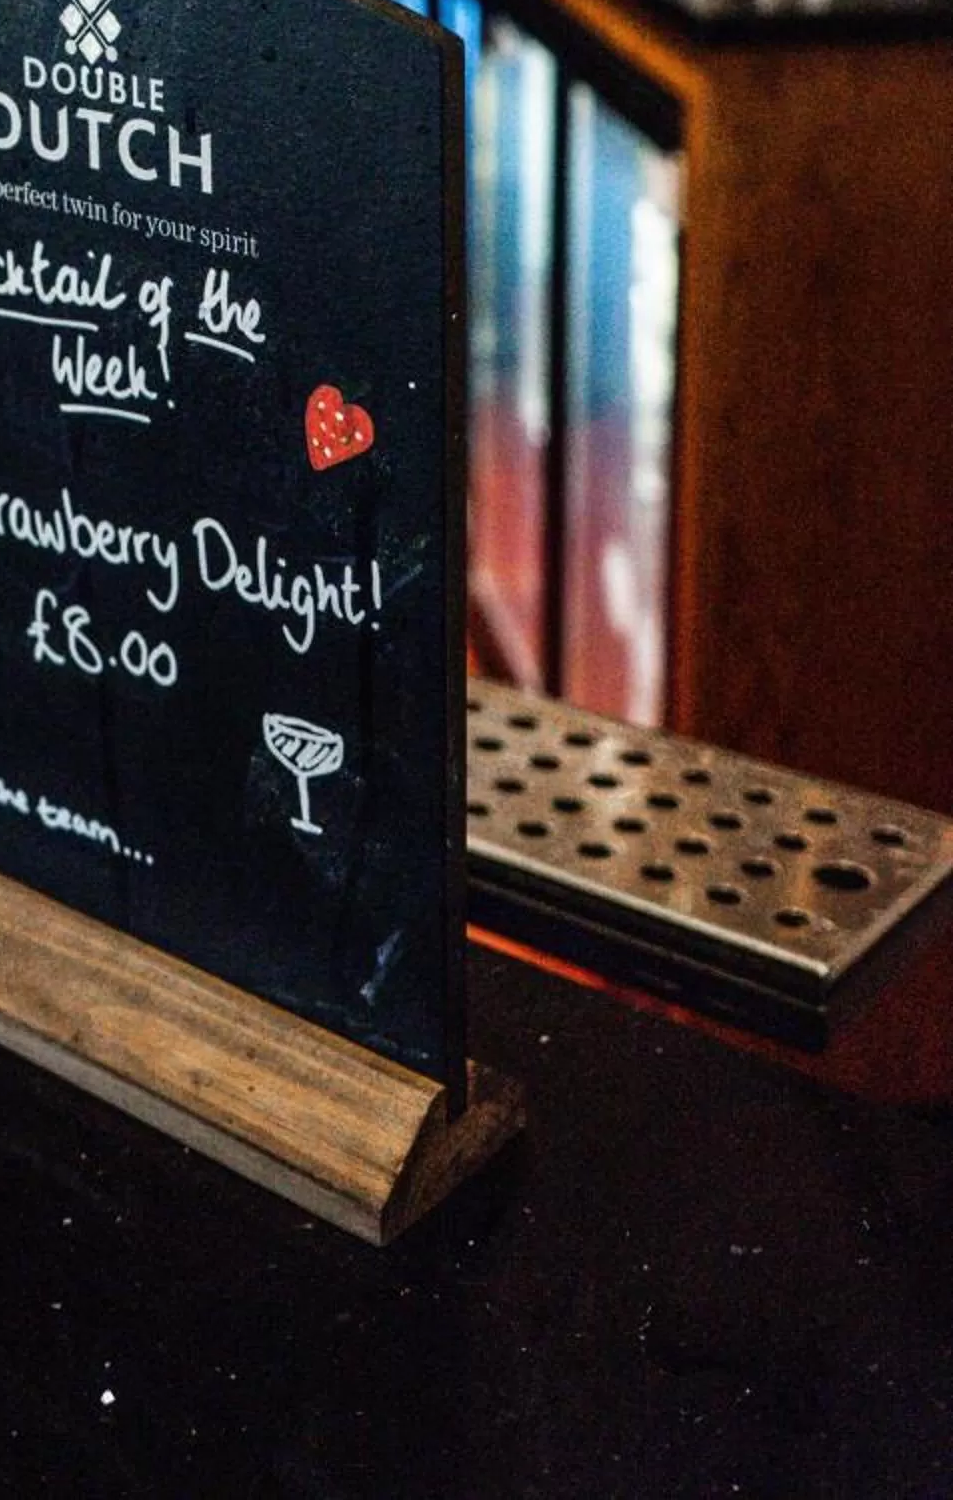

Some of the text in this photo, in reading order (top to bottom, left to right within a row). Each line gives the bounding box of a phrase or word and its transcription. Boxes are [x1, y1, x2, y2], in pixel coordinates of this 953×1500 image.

[23, 56, 165, 113] DOUBLE
[62, 195, 108, 223] twin
[112, 201, 144, 230] for
[146, 214, 196, 243] your
[200, 225, 260, 259] spirit
[138, 275, 175, 346] of
[198, 268, 266, 344] the
[193, 517, 383, 654] Delight!
[27, 589, 179, 686] £8.00
